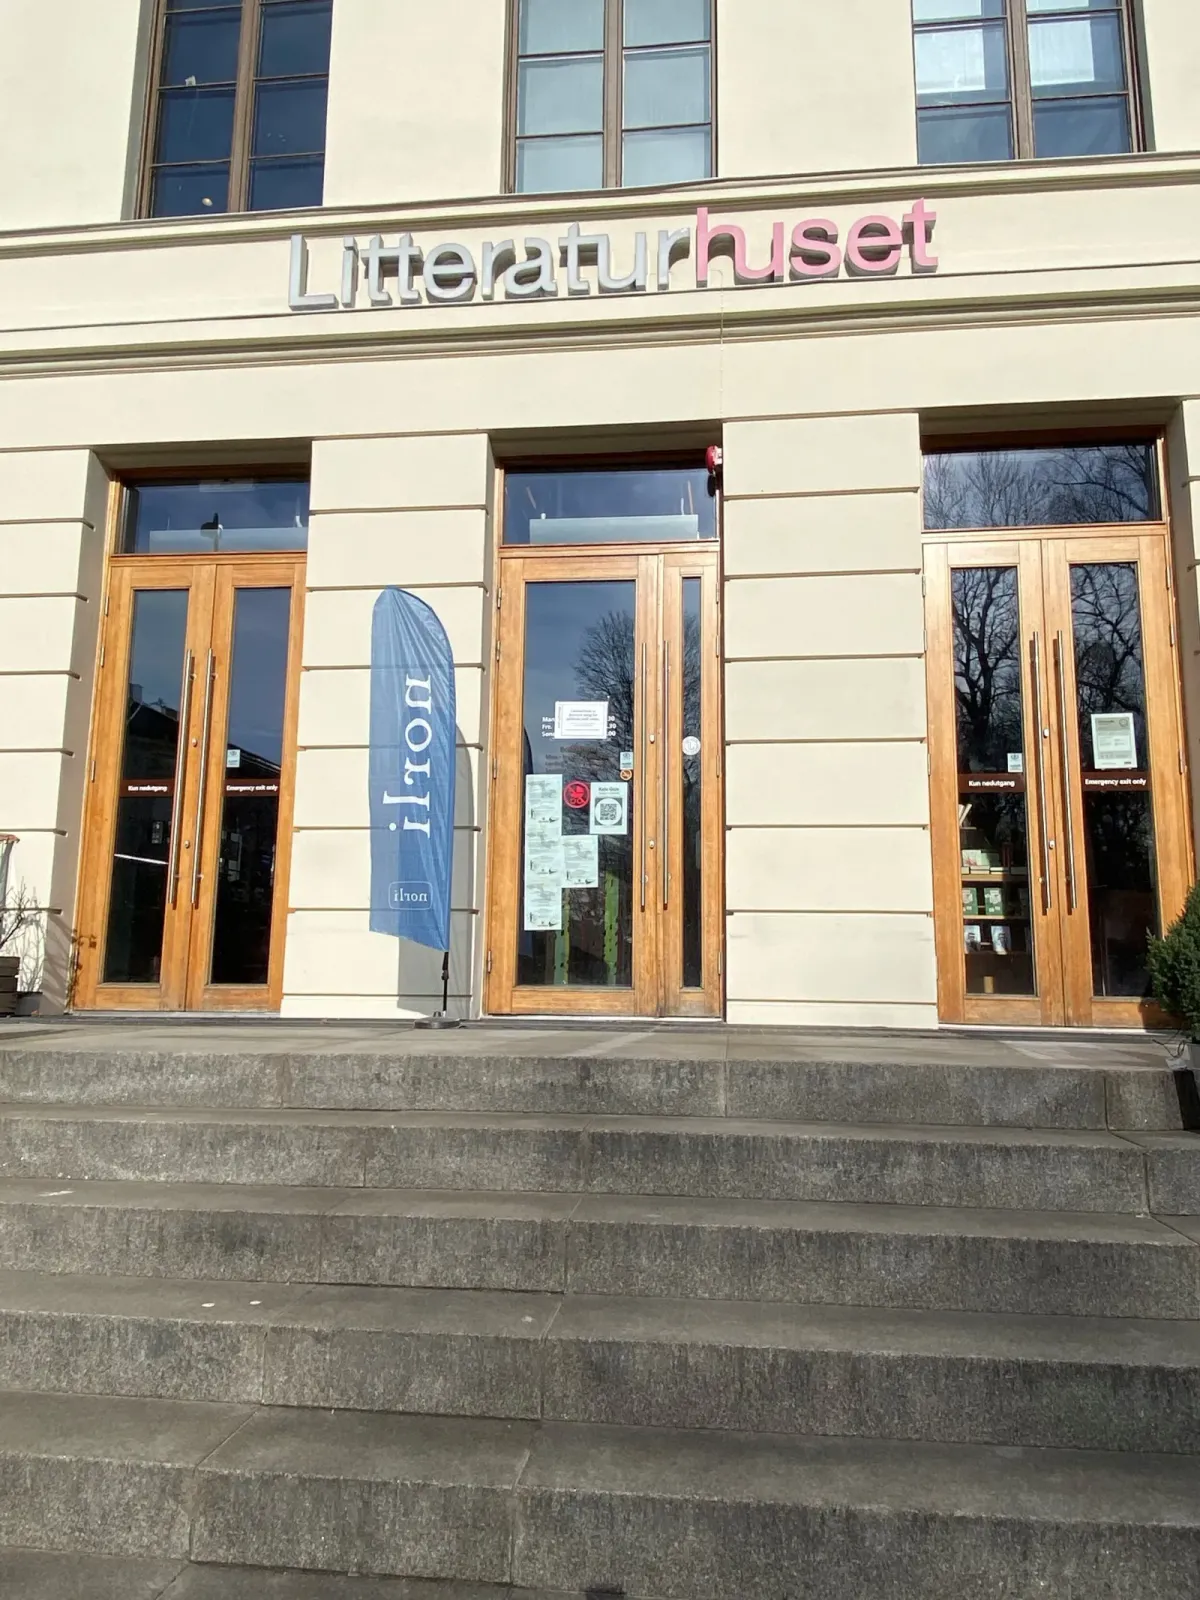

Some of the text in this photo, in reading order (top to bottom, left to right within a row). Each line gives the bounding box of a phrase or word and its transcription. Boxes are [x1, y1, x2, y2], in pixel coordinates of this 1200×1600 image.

[289, 198, 938, 311] Litteraturhuset
[1084, 778, 1118, 786] Emergency
[1132, 778, 1146, 786] only
